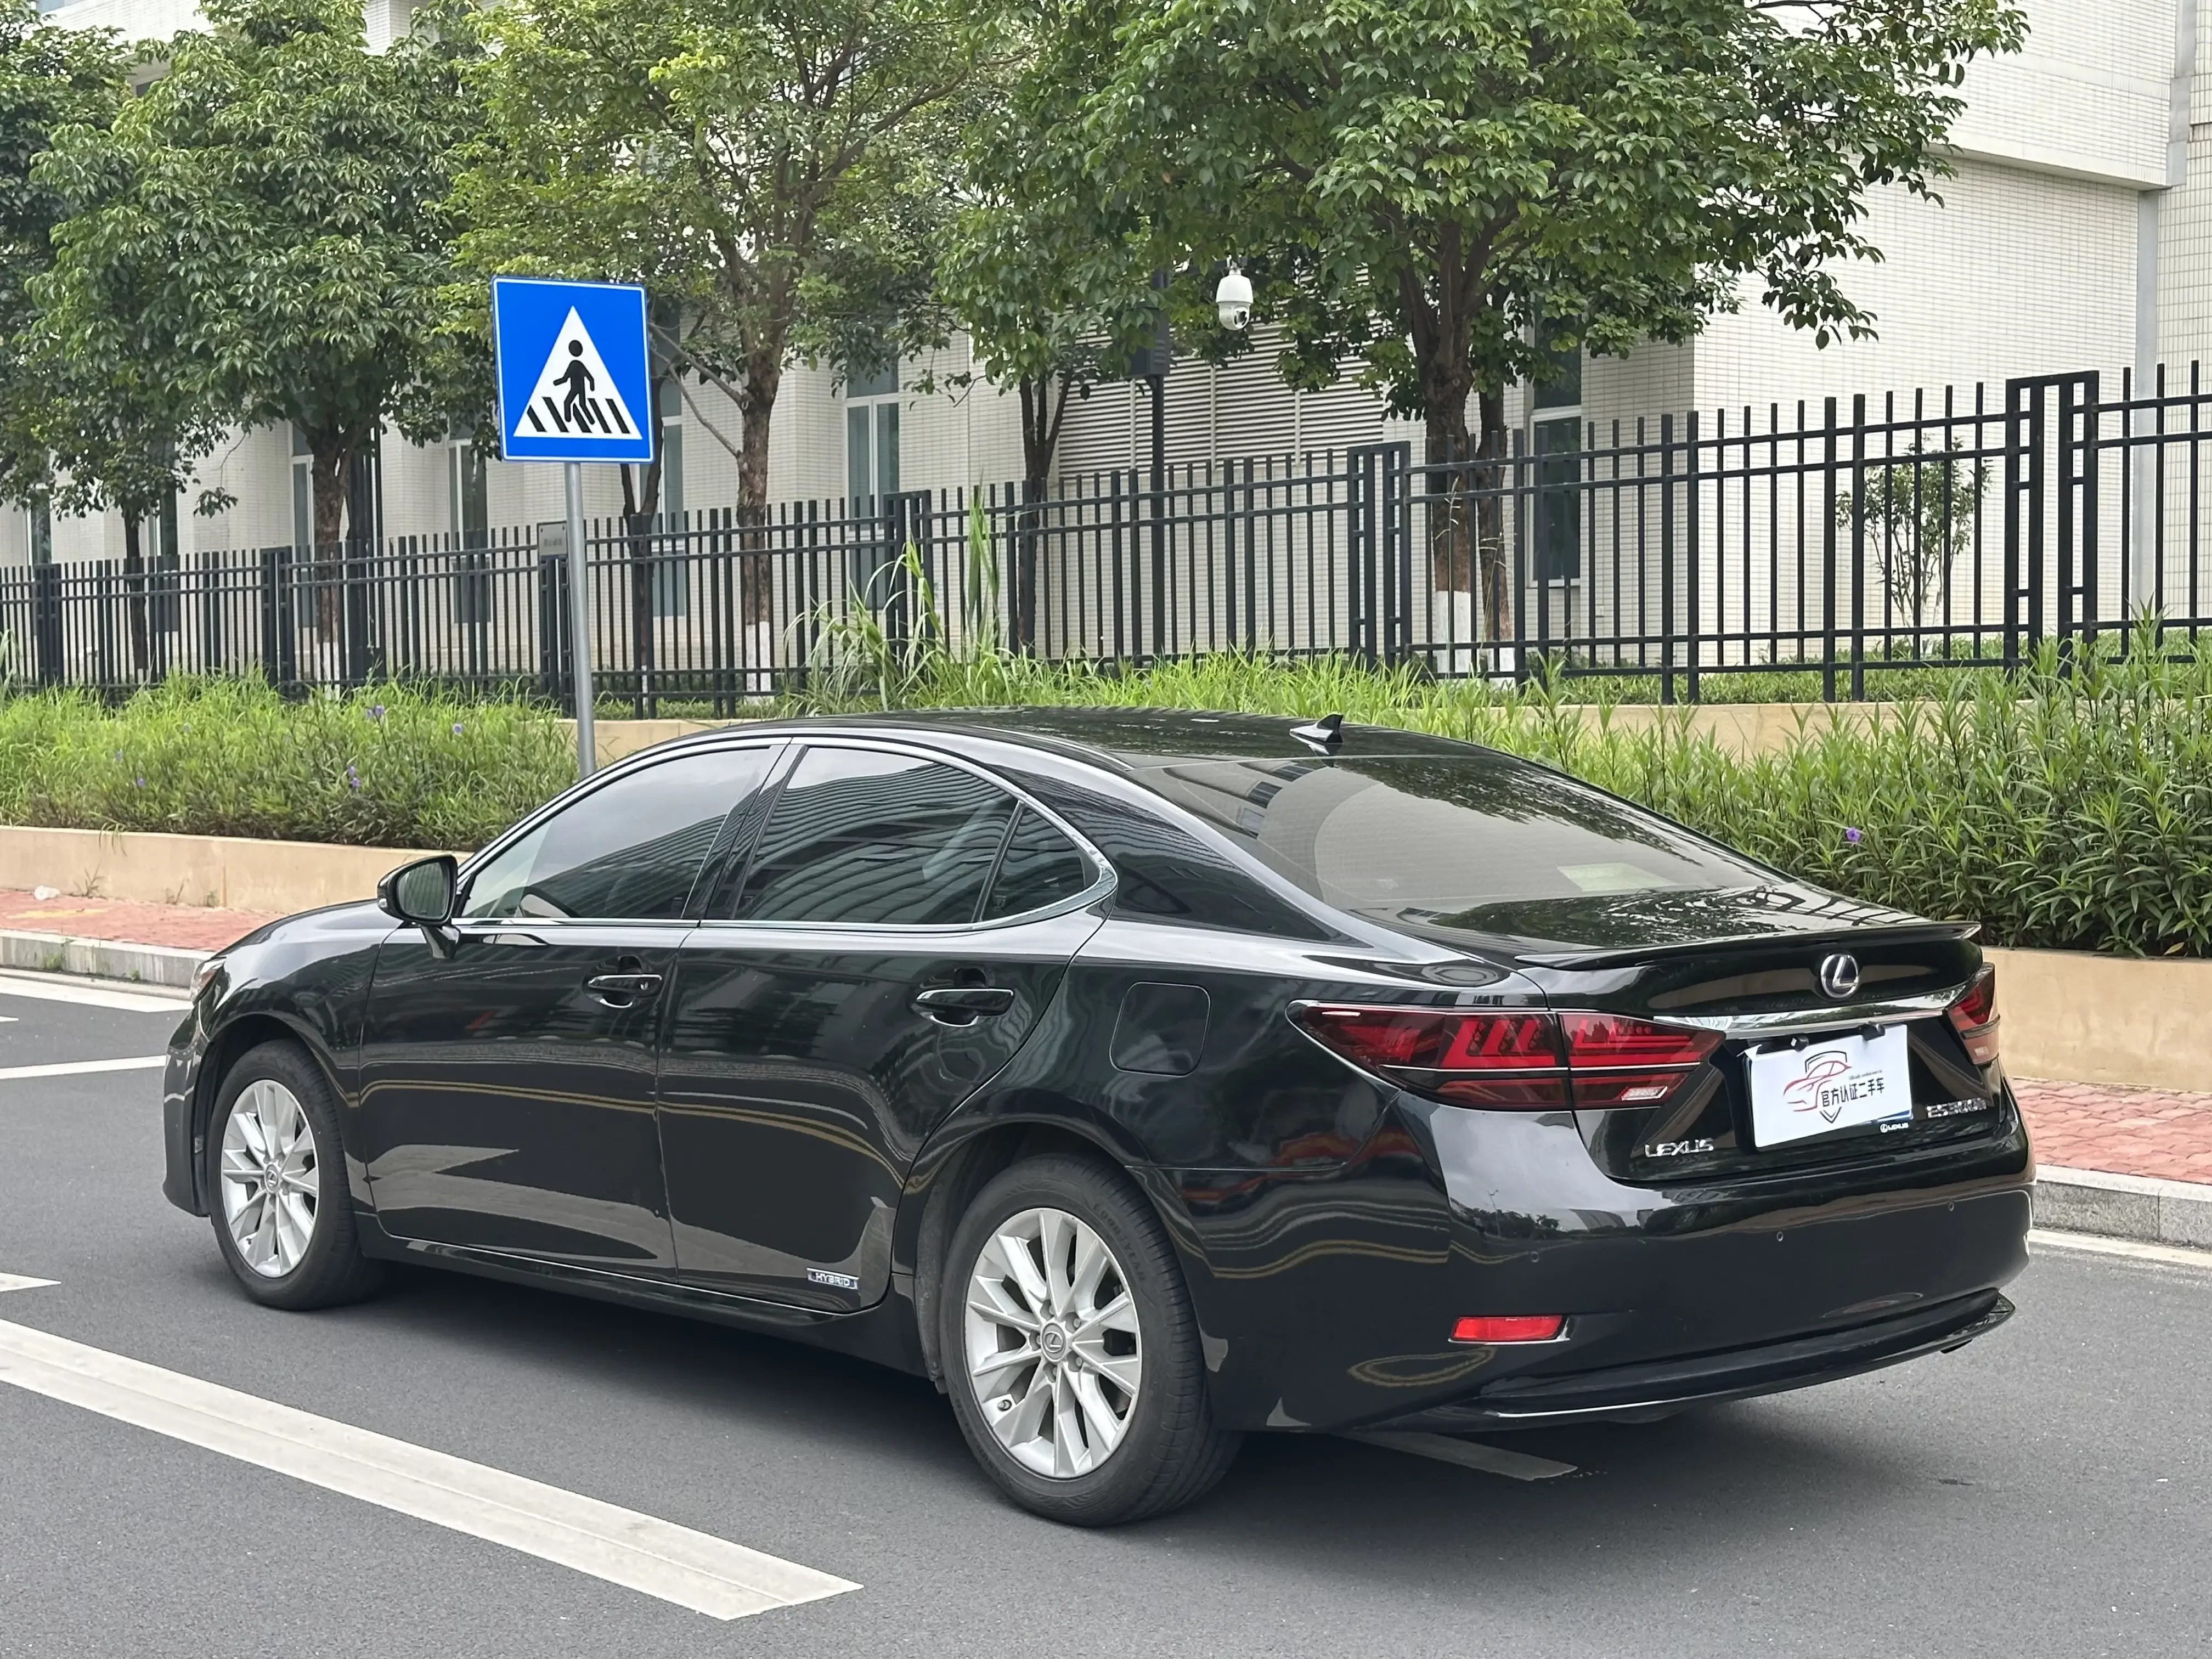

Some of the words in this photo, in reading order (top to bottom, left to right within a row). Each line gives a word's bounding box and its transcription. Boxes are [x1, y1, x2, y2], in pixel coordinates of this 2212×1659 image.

[1821, 1077, 1884, 1107] 官方认证二手车
[1645, 1138, 1714, 1157] LEXUS
[815, 1272, 850, 1286] HYBRID
